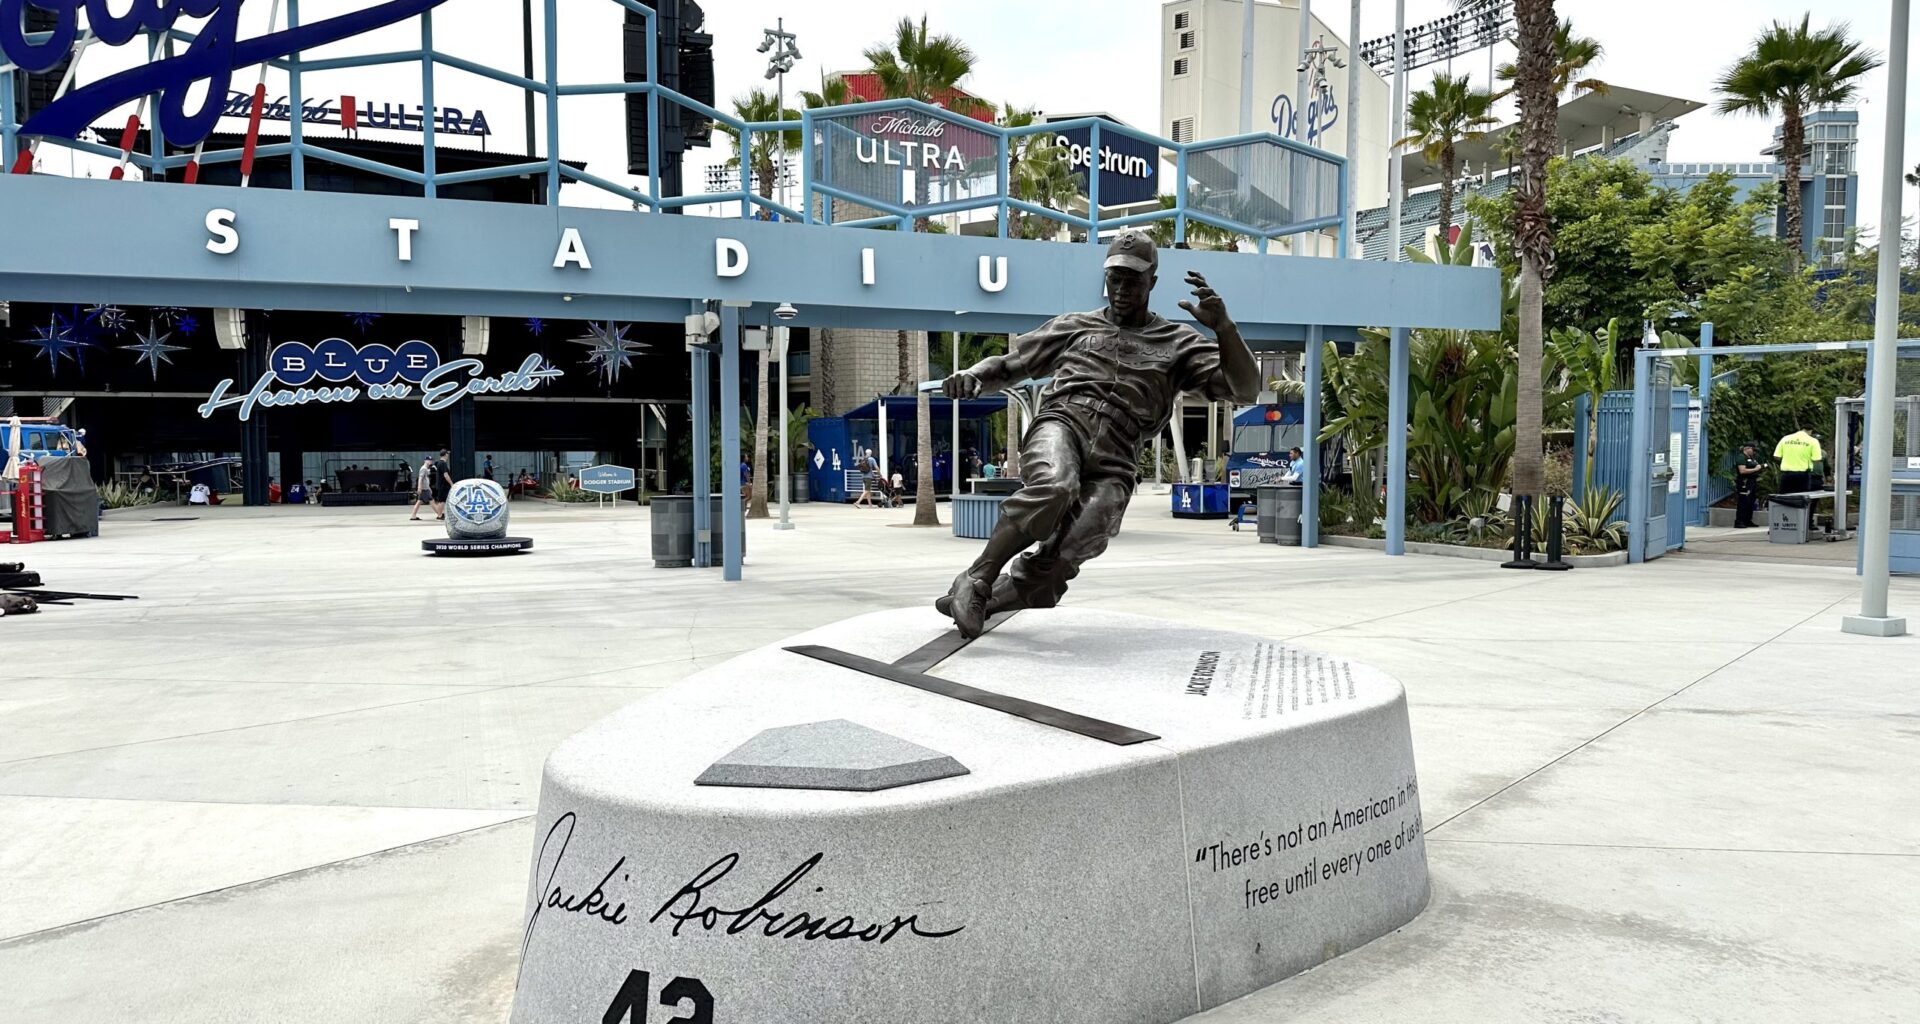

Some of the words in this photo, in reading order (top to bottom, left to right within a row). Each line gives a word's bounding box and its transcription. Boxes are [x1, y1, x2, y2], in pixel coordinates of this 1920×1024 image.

[871, 116, 946, 138] Michelob
[856, 137, 965, 170] ULTRA
[1056, 135, 1147, 178] Spectrum
[282, 352, 428, 373] BLUE
[197, 371, 360, 422] Heaven
[368, 382, 412, 400] on
[420, 353, 564, 411] Earth
[832, 448, 841, 470] LA
[465, 484, 493, 514] LA
[1182, 488, 1191, 508] LA
[1192, 650, 1221, 677] ROBINSON
[1184, 676, 1213, 697] JACKIE
[1277, 823, 1304, 852] not
[1307, 820, 1327, 842] an
[1332, 796, 1395, 834] American
[1397, 786, 1405, 808] in
[1245, 879, 1279, 909] free
[1285, 857, 1317, 894] until
[1322, 850, 1363, 880] every
[1367, 839, 1391, 863] one
[1394, 821, 1405, 850] of
[1406, 824, 1415, 842] us
[516, 811, 628, 991] Jackie
[649, 852, 966, 944] Robinson
